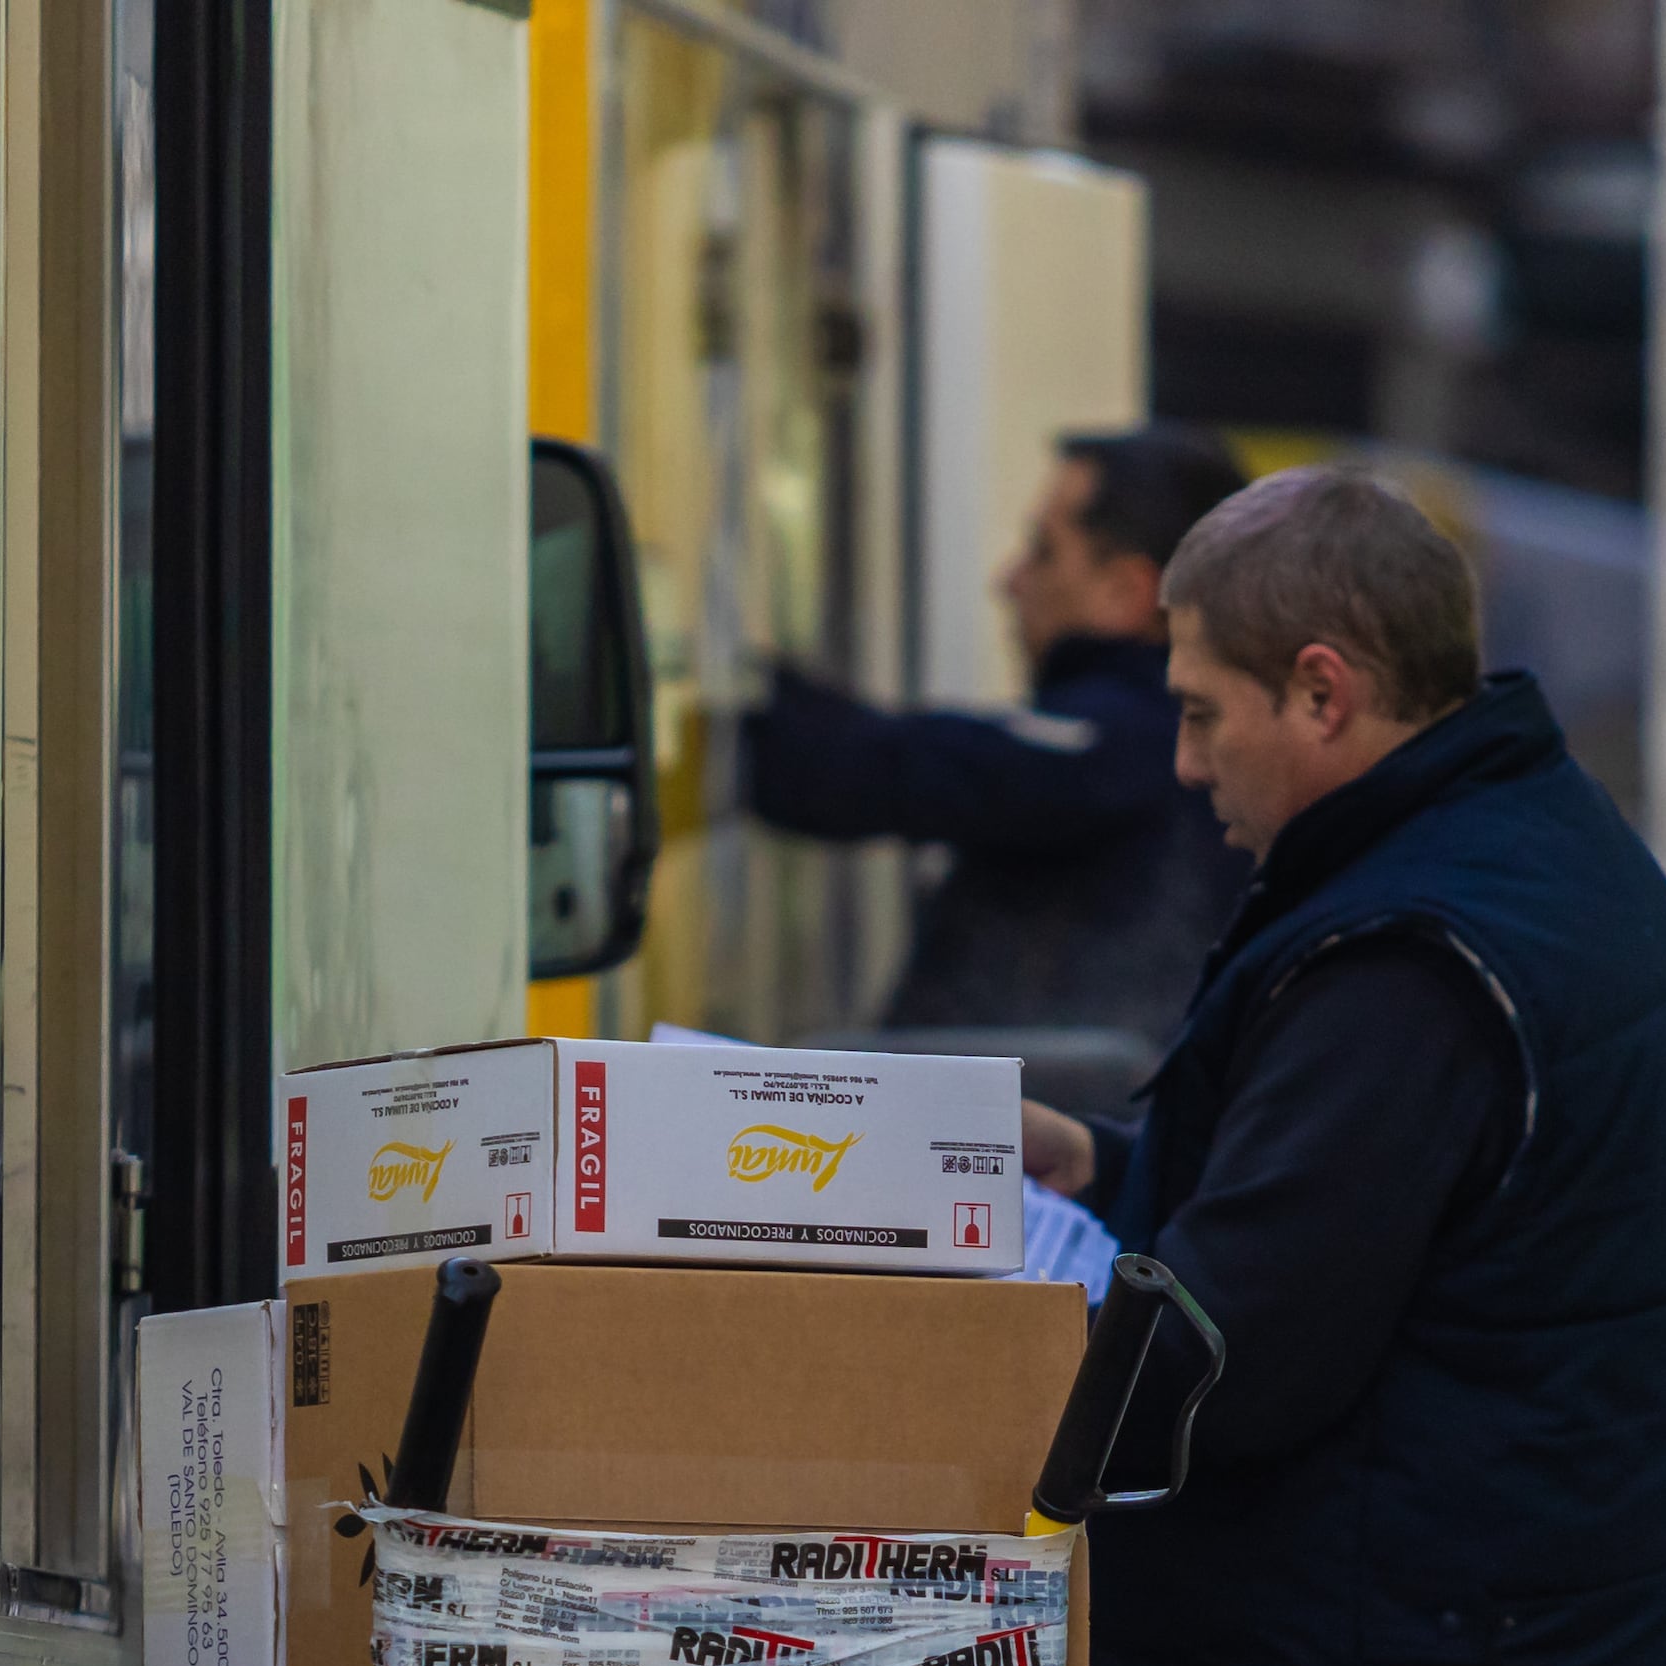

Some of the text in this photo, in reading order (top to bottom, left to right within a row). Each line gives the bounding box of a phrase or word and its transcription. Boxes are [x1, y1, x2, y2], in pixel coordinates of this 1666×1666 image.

[729, 1089, 865, 1106] A COCIÑA DE LUMAI S.L.
[367, 1138, 458, 1204] Lumai
[580, 1086, 601, 1209] FRAGIL
[726, 1124, 867, 1193] Lumai
[290, 1121, 303, 1244] FRAGIL
[341, 1229, 476, 1258] COCINADOS Y PRECOCINADOS
[688, 1223, 898, 1244] COCINADOS Y PRECOCINADOS
[210, 1367, 223, 1425] Ctra.
[211, 1429, 224, 1509] Toledo
[167, 1474, 183, 1577] (TOLEDO)
[181, 1380, 200, 1666] VAL DE SANTO DOMINGO
[196, 1392, 214, 1650] Teléfono 925 77 95 63
[771, 1536, 988, 1581] RADITHERM
